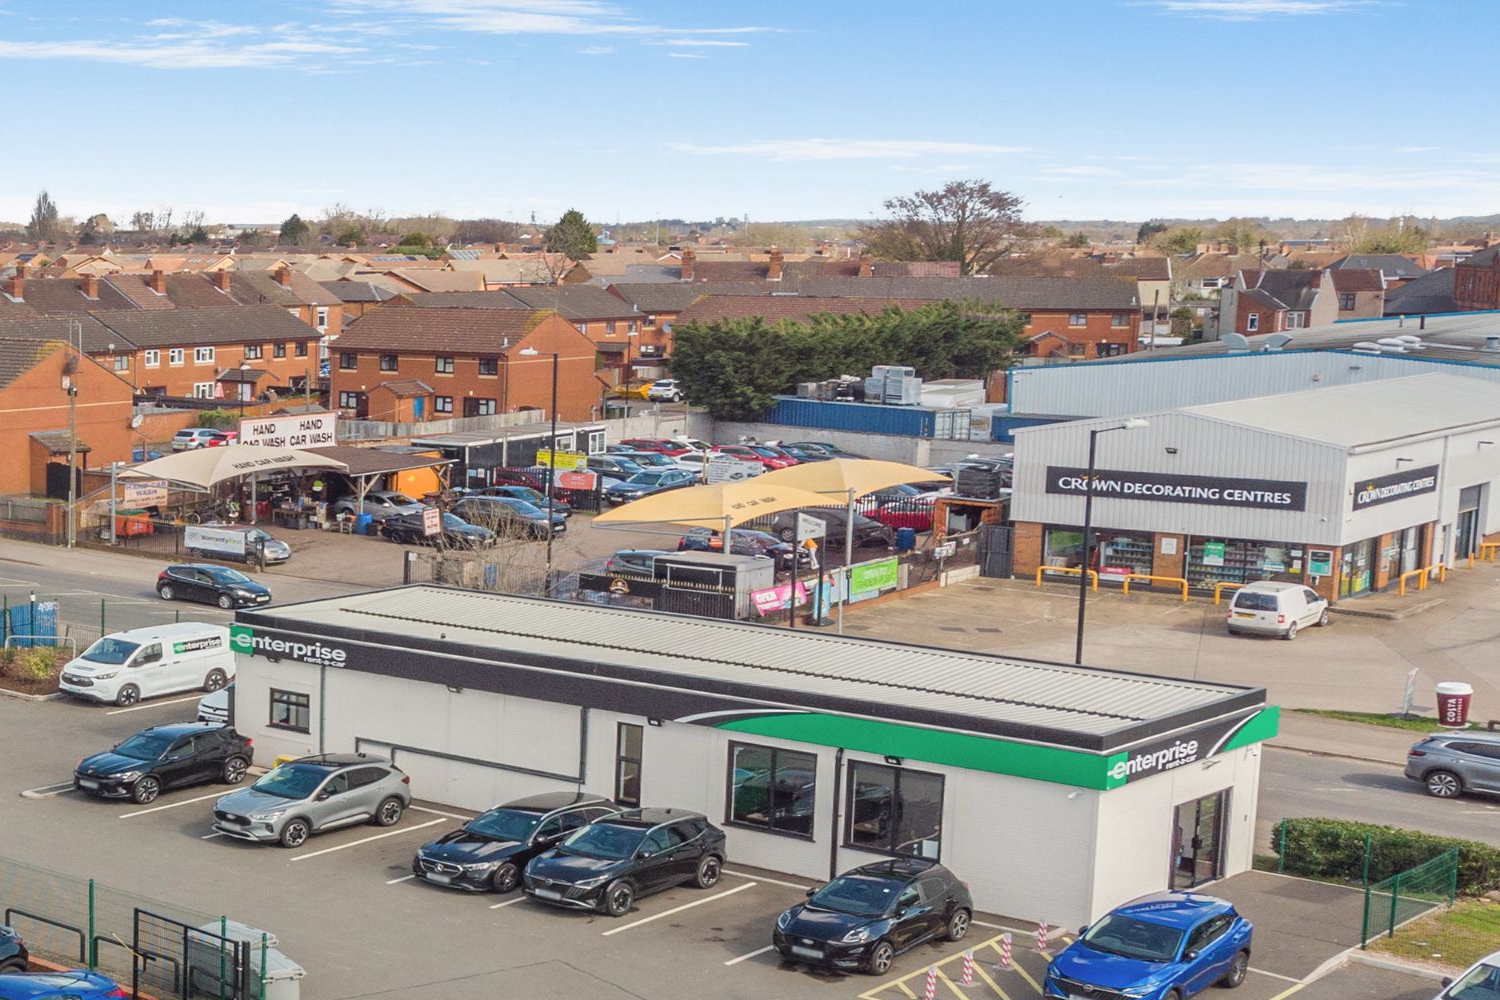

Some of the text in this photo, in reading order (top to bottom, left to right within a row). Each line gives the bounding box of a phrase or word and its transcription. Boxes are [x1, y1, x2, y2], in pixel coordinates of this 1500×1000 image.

[253, 423, 276, 435] HAND
[300, 419, 323, 431] HAND
[262, 436, 286, 447] WASH
[290, 432, 333, 446] CAR WASH
[232, 454, 297, 470] HAND CAR WASH
[1124, 482, 1220, 499] DECORATING
[1223, 489, 1291, 504] CENTRES
[1358, 488, 1381, 504] CROWN
[1381, 481, 1413, 498] DECORATING
[175, 638, 221, 651] enterprise
[231, 633, 347, 661] enterprise
[303, 656, 346, 668] rent-a-car
[1107, 740, 1198, 779] enterprise
[1165, 755, 1197, 770] rent-a-car
